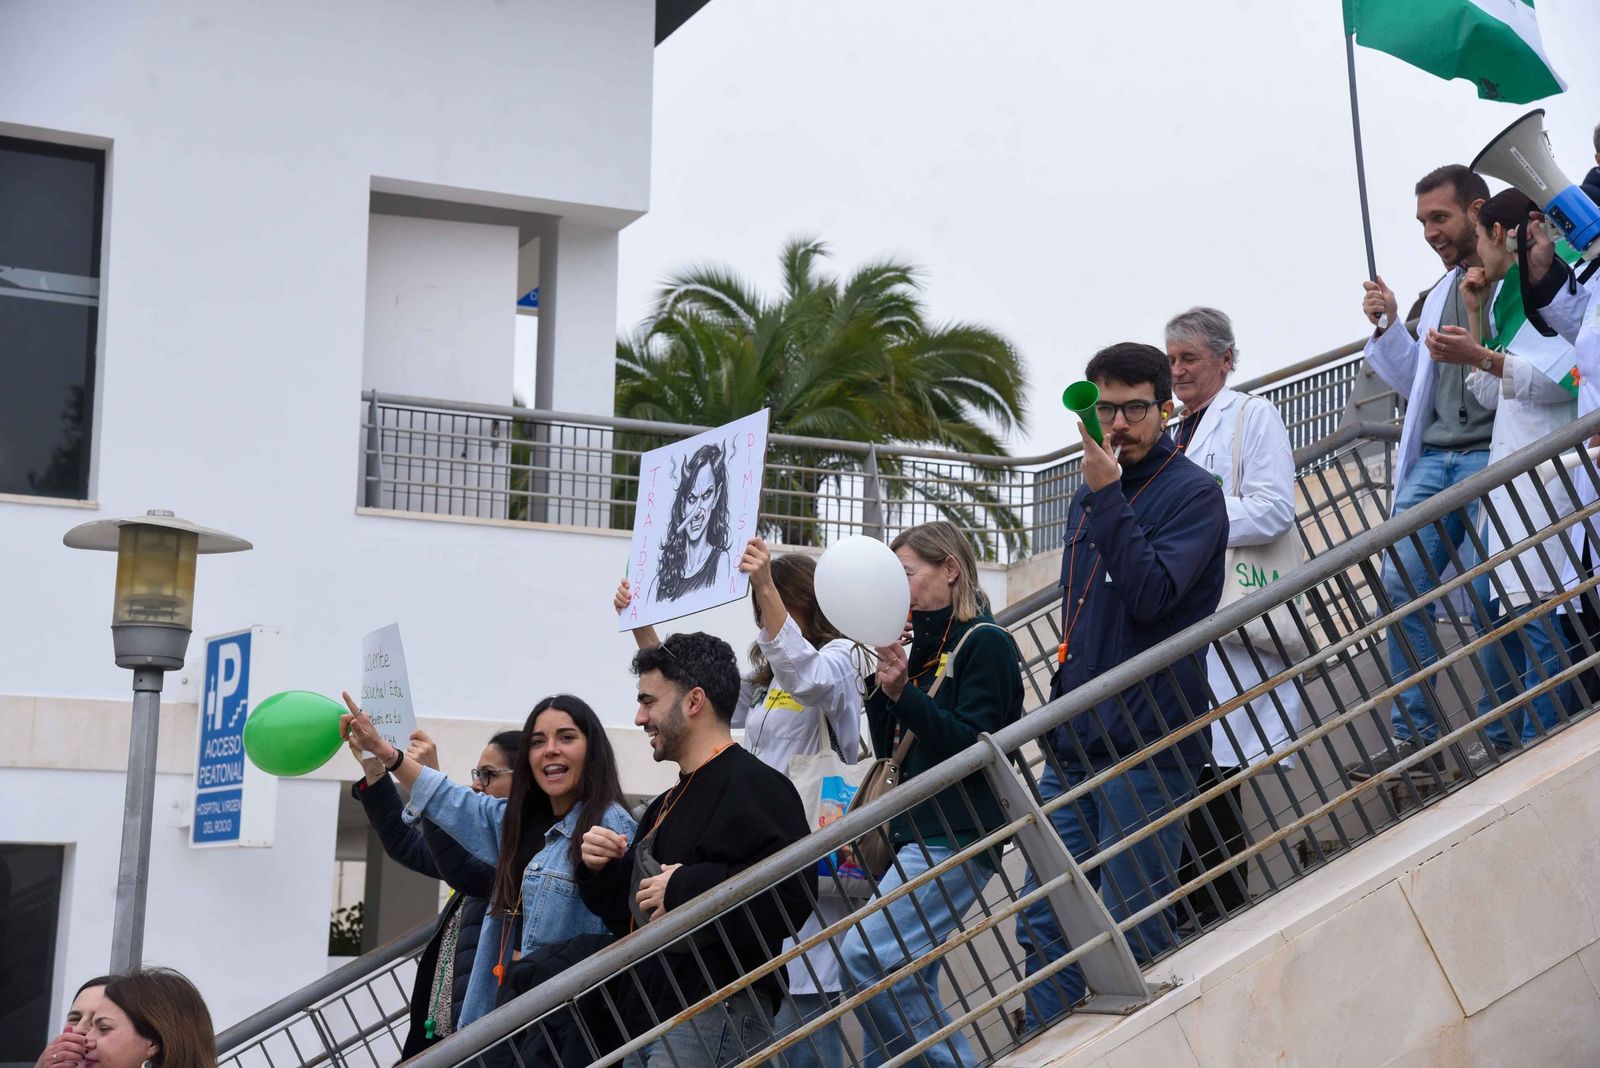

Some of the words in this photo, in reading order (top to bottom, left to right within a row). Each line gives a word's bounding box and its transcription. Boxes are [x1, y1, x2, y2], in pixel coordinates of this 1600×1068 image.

[629, 465, 661, 620] TRAIDORA
[214, 642, 242, 730] P
[204, 735, 241, 759] ACCESO
[199, 762, 243, 785] PEATONAL
[196, 801, 221, 816] HOSPITAL
[221, 799, 241, 812] VIRGEN
[203, 821, 214, 834] DEL
